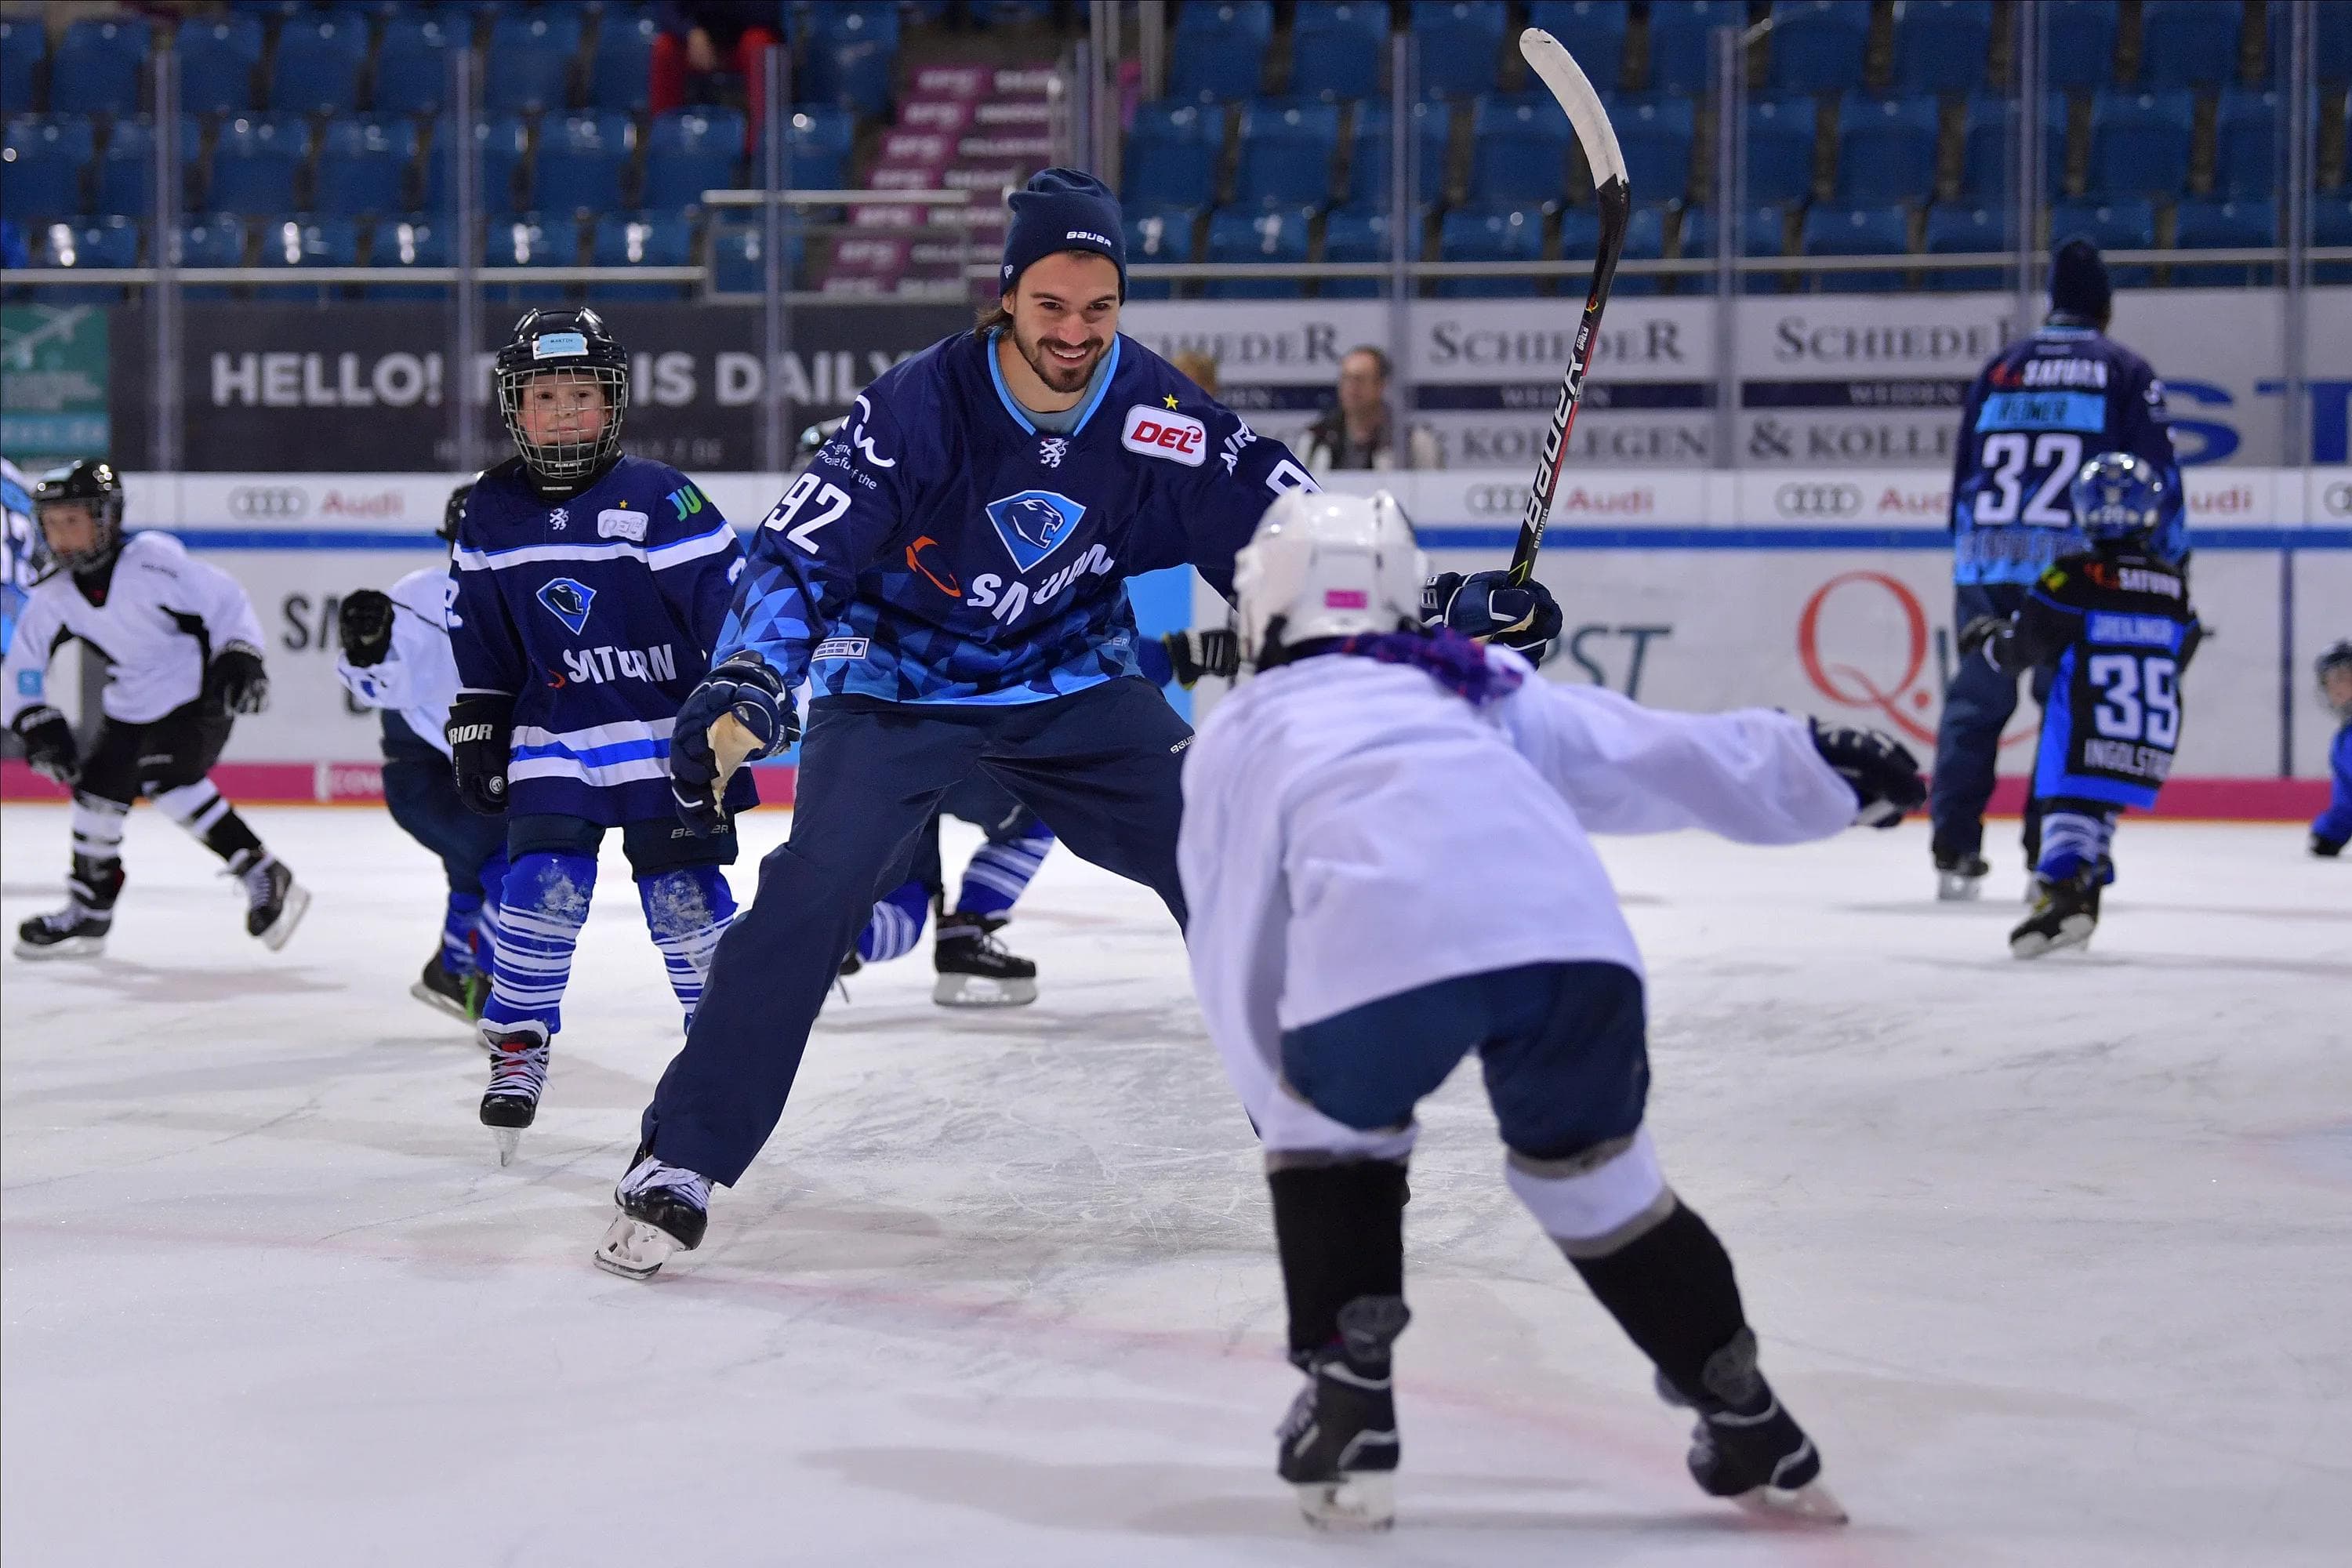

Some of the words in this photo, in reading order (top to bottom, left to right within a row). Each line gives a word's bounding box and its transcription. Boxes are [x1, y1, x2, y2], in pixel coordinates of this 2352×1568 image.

[211, 351, 444, 407] HELLO!
[1524, 352, 1584, 534] BAUER
[1564, 486, 1655, 516] Audi
[1973, 432, 2084, 528] 32
[2187, 484, 2254, 515] udi
[764, 472, 851, 555] 92
[1534, 508, 1550, 549] BAUER
[562, 644, 677, 684] SATURN
